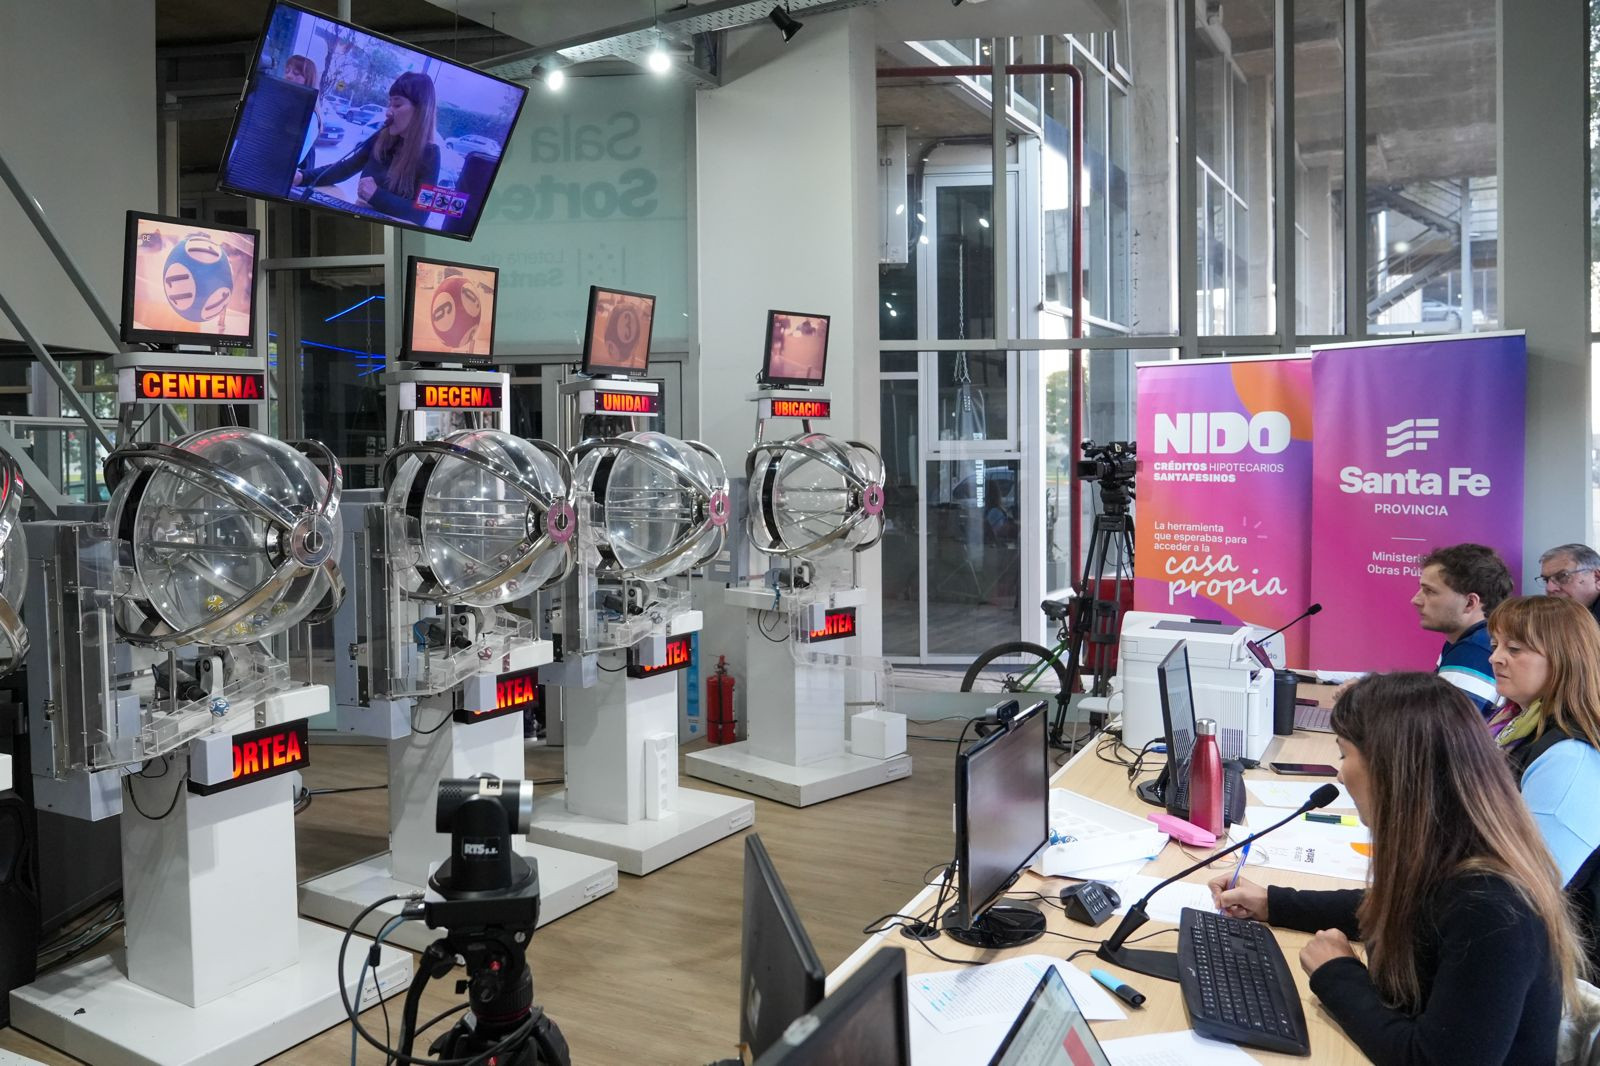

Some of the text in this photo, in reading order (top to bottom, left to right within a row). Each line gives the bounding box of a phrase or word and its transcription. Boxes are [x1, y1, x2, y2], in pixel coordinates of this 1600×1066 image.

[142, 372, 259, 399] CENTENA
[425, 386, 493, 406] DECENA
[603, 393, 651, 411] UNIDAD
[1154, 411, 1291, 454] NIDO
[1153, 460, 1285, 473] CRÉDITOS HIPOTECARIOS
[1153, 473, 1236, 483] SANTAFESINOS
[1339, 466, 1491, 497] Santa Fe
[1374, 503, 1448, 516] PROVINCIA
[1154, 521, 1224, 533] La herramienta
[1154, 533, 1248, 545] que esperabas para
[1154, 542, 1191, 552] acceder
[1202, 544, 1210, 552] la
[1165, 554, 1239, 577] casa
[1367, 563, 1400, 576] Obras
[1168, 568, 1288, 606] propia
[810, 613, 853, 638] RTEA
